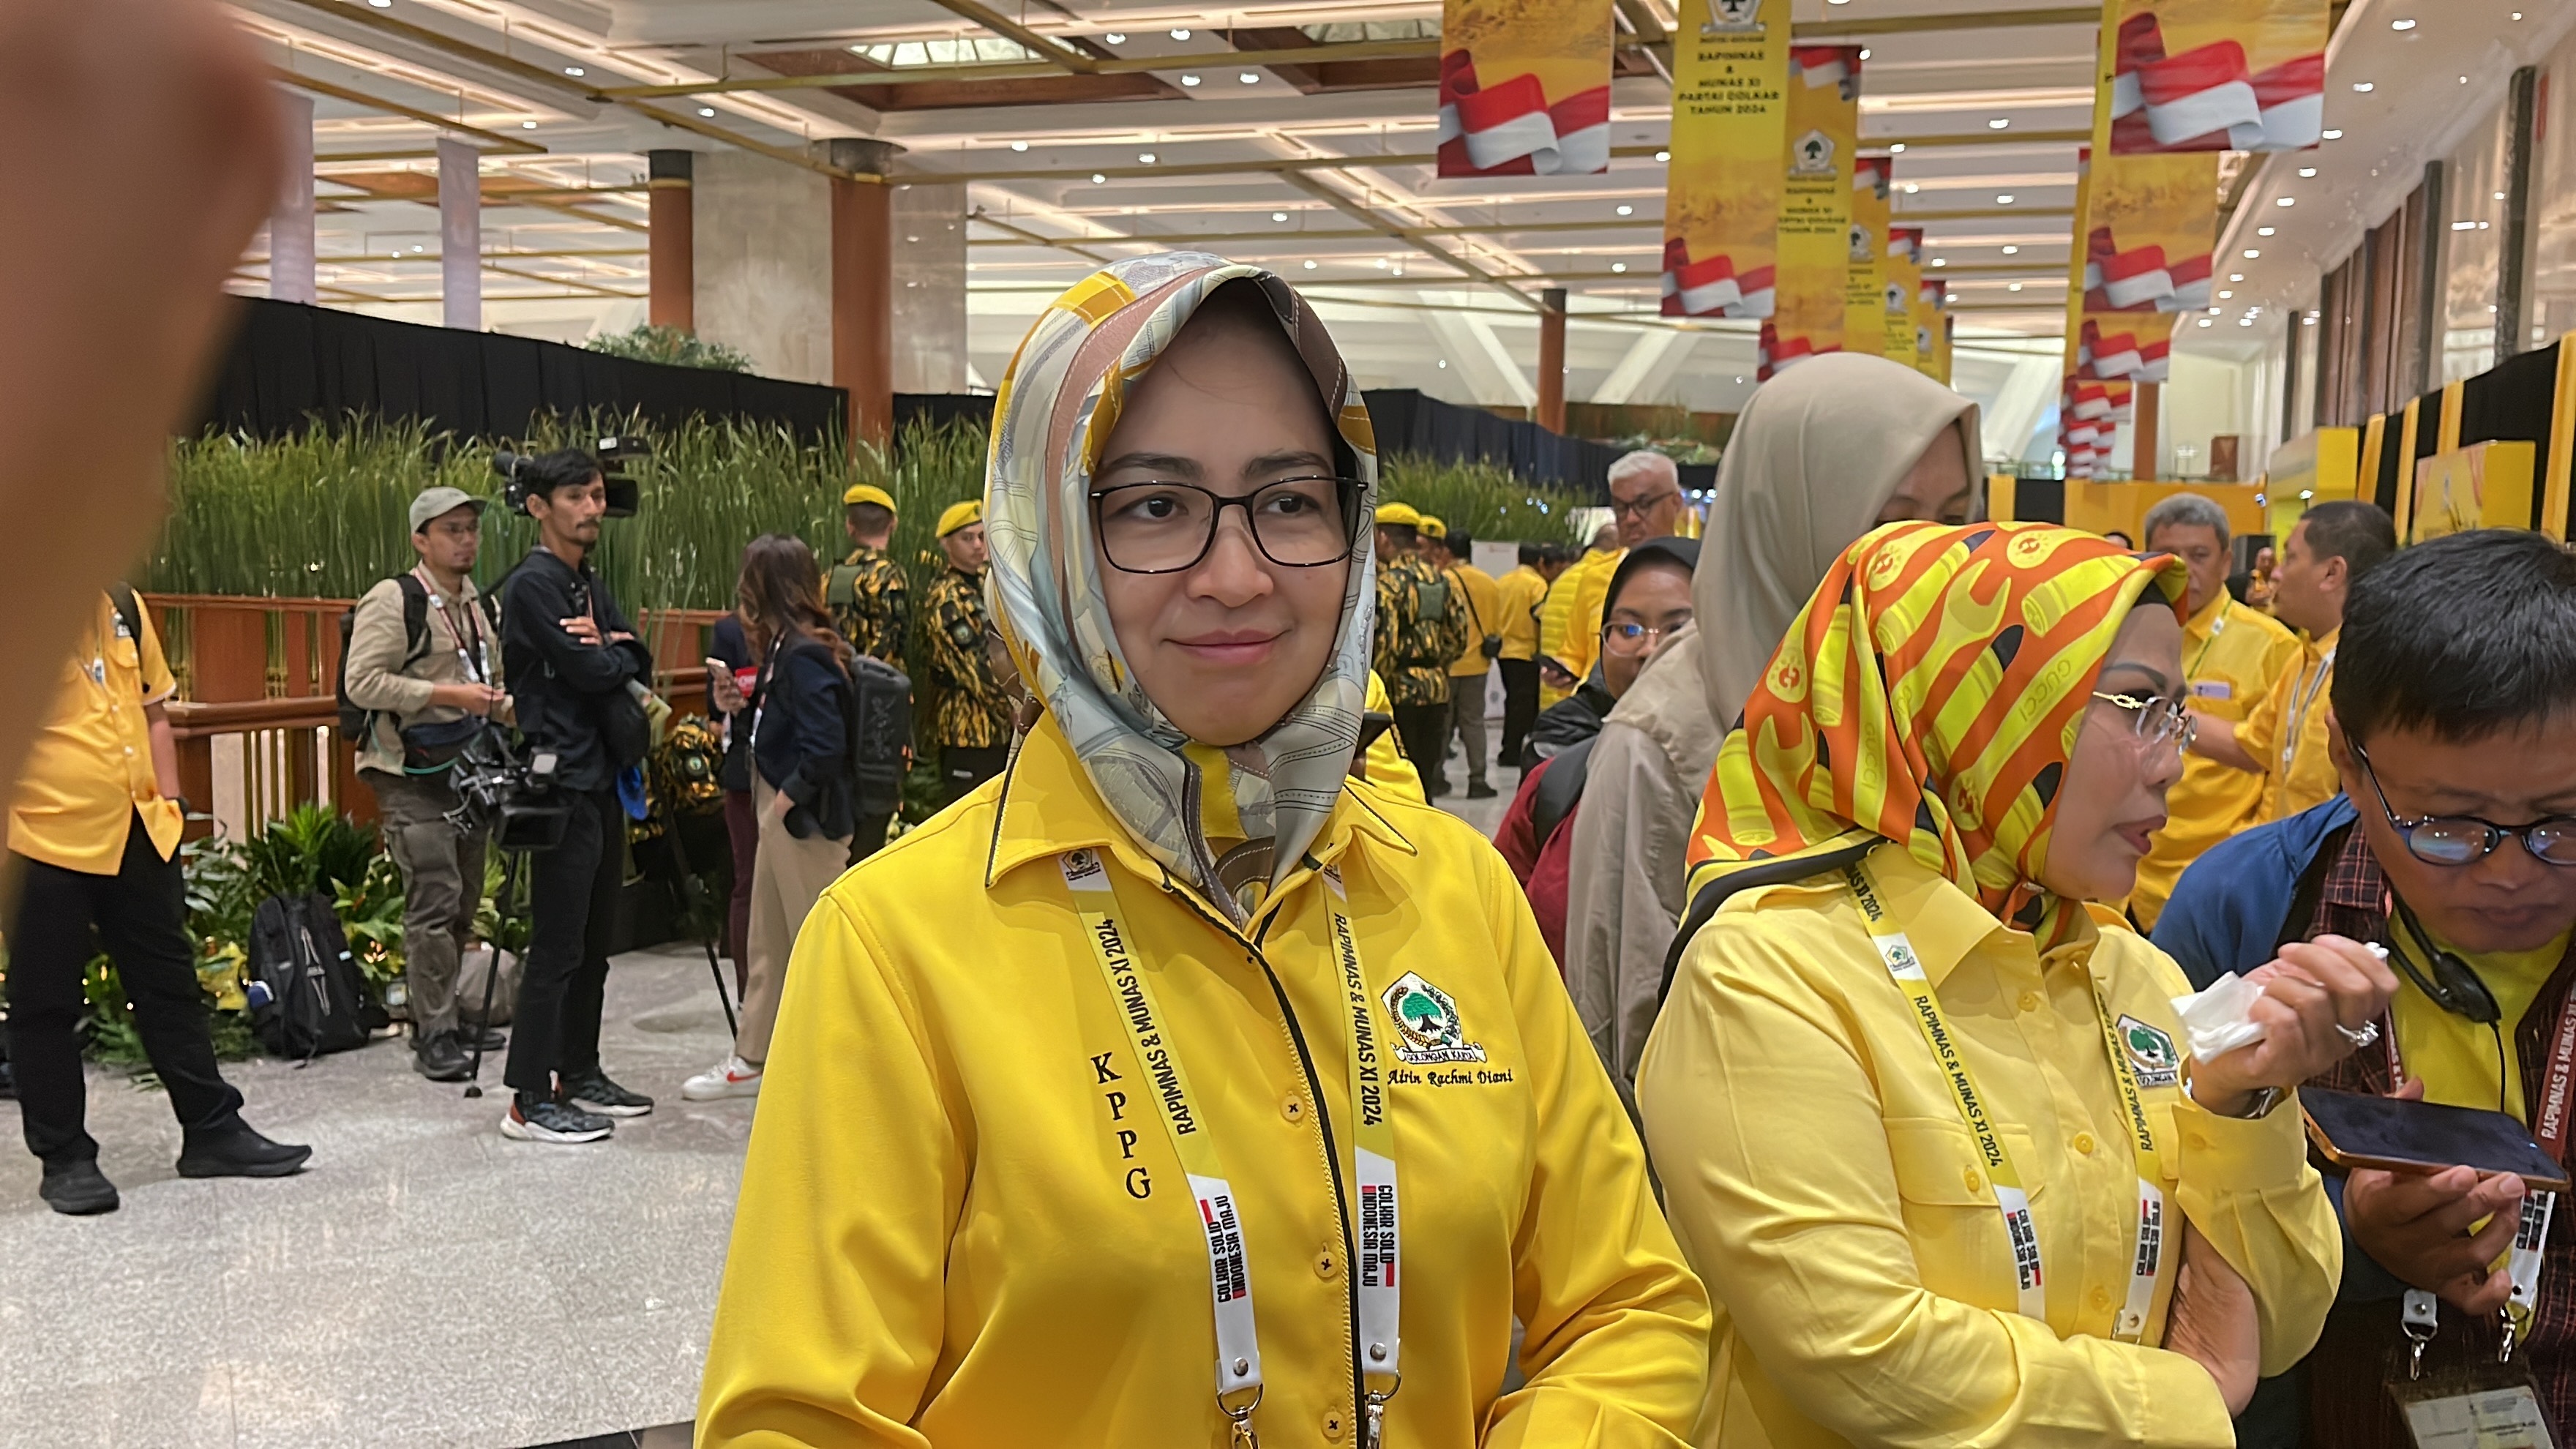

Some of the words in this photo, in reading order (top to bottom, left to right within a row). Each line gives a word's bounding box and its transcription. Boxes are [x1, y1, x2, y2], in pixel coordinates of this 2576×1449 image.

[2020, 659, 2071, 722] GUCCI
[1096, 918, 1126, 957] 2024
[1334, 913, 1362, 991] RAPIMNAS
[1109, 957, 1133, 976] XI
[1117, 976, 1155, 1033] MUNAS
[1349, 989, 1365, 1003] &
[1141, 1033, 1161, 1047] &
[1352, 1006, 1376, 1064] MUNAS
[1914, 995, 1955, 1061] RAPIMNAS
[1359, 1065, 1378, 1081] XI
[1388, 1068, 1422, 1085] Airin
[1427, 1068, 1474, 1087] Rachmi
[1477, 1068, 1513, 1085] Diani
[1946, 1060, 1960, 1071] &
[1147, 1048, 1197, 1136] RAPIMNAS
[1361, 1085, 1382, 1126] 2024
[1952, 1071, 1982, 1120] MUNAS
[1980, 1133, 2004, 1168] 2024
[1215, 1195, 1236, 1229] MAJU
[1362, 1192, 1378, 1250] INDONESIA
[1208, 1221, 1226, 1255] SOLID
[1379, 1229, 1395, 1264] SOLID
[1225, 1231, 1246, 1292] INDONESIA
[1363, 1253, 1378, 1287] MAJU
